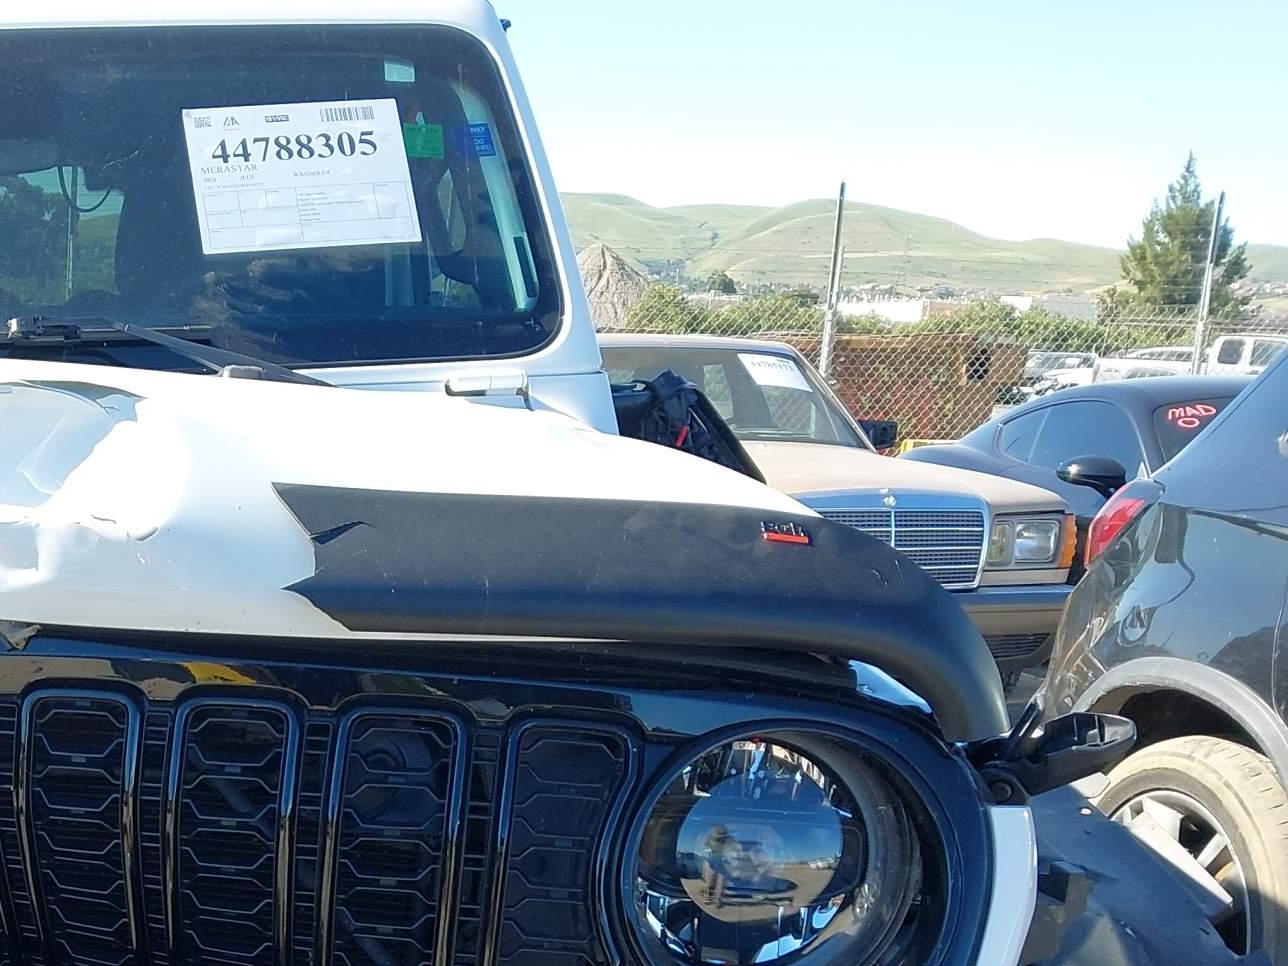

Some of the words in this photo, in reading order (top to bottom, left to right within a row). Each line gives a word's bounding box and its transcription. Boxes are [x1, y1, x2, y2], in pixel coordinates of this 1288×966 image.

[211, 131, 378, 163] 44788305
[200, 163, 259, 175] MERASTAR
[1168, 404, 1217, 420] MAD
